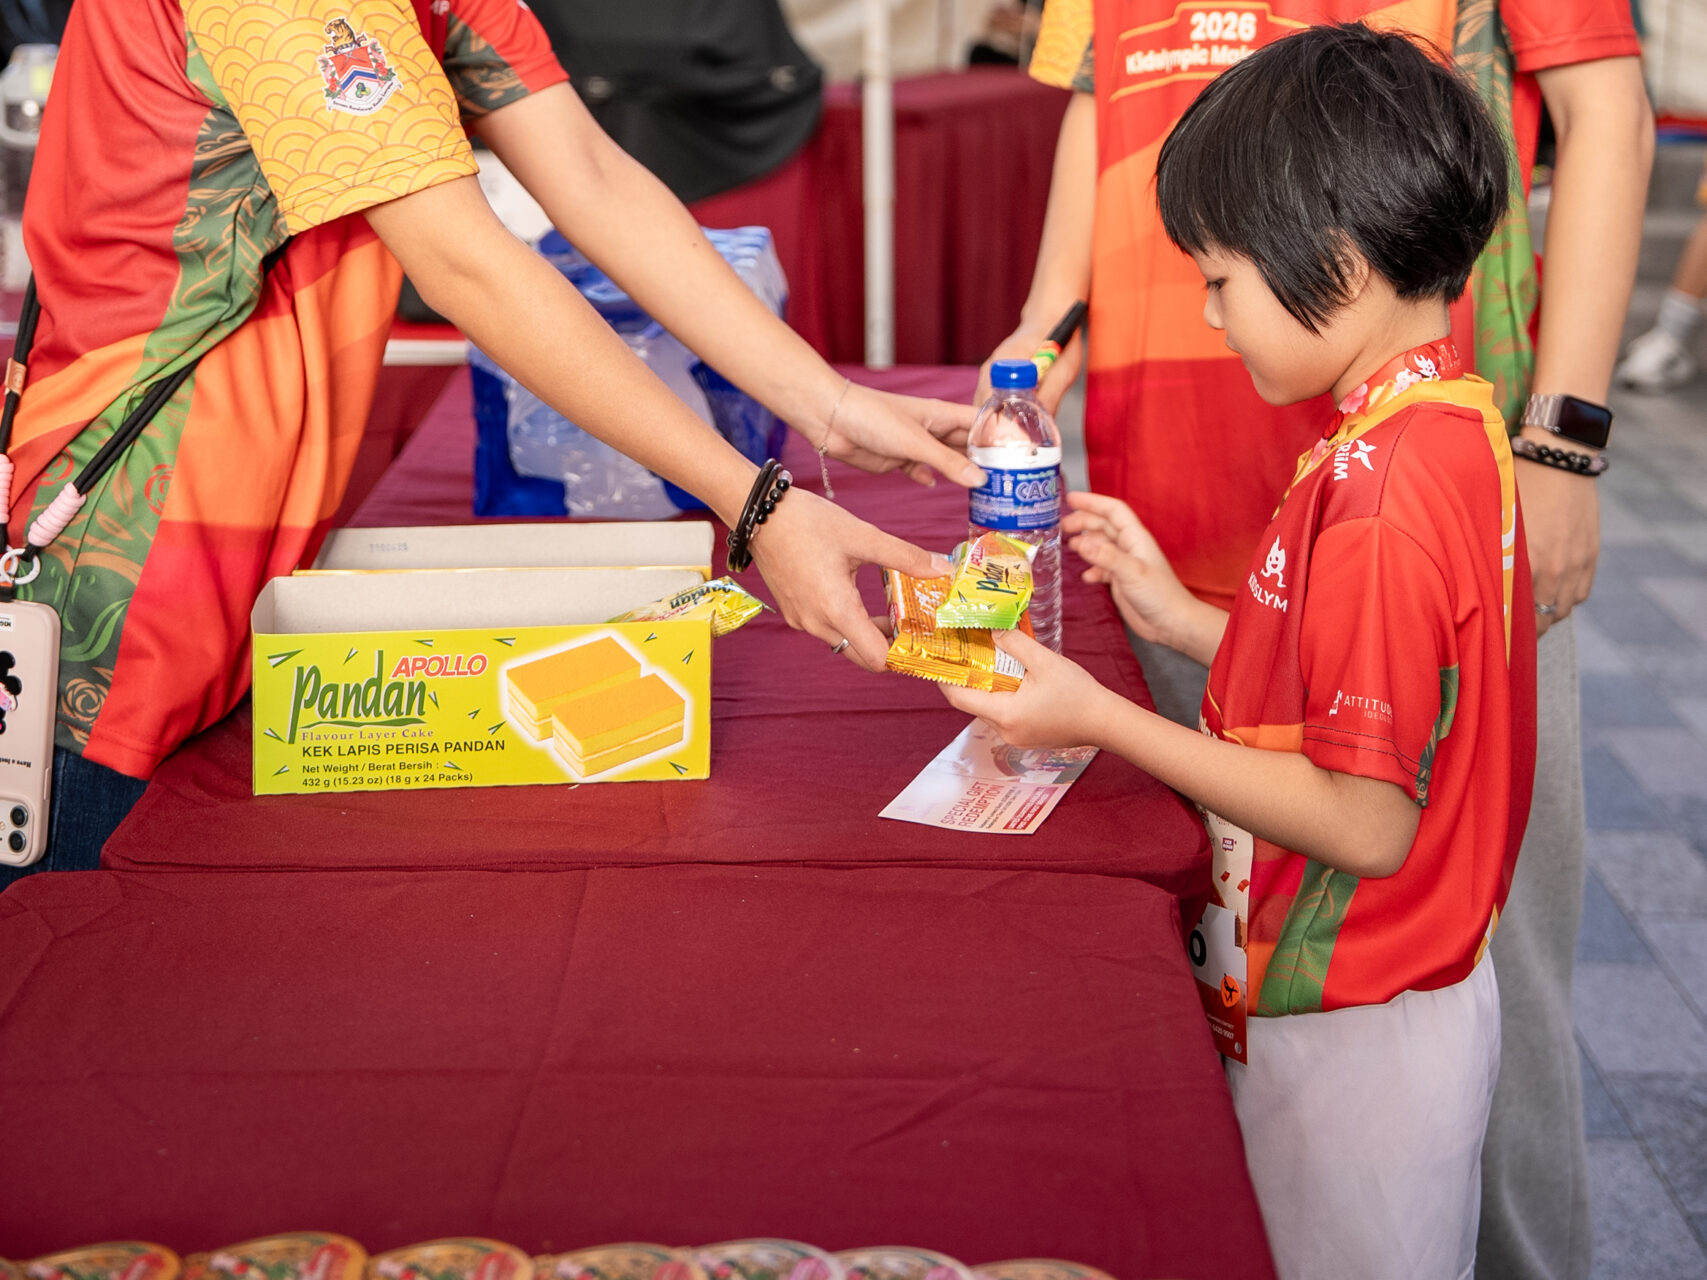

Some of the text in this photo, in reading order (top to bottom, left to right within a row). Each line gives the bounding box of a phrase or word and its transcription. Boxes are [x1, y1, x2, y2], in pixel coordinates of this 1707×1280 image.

[1190, 11, 1257, 42] 2026
[1126, 43, 1209, 75] Kidslympic
[391, 654, 488, 678] APOLLO
[288, 650, 426, 744] Pandan
[302, 728, 434, 741] Flavour Layer Cake
[302, 740, 505, 757] KEK LAPIS PERISA PANDAN
[302, 765, 320, 774] Net
[323, 763, 359, 774] Weight
[368, 762, 396, 771] Berat
[399, 761, 433, 770] Bersih
[302, 778, 321, 787] 432
[324, 779, 331, 788] g
[333, 776, 366, 788] (15.23
[367, 775, 383, 786] oz)
[385, 775, 402, 785] (18
[404, 776, 412, 785] g
[423, 773, 436, 782] 24
[438, 772, 473, 783] Packs)
[940, 781, 990, 825] SPECIAL GIFT
[957, 783, 1006, 828] REDEMPTION
